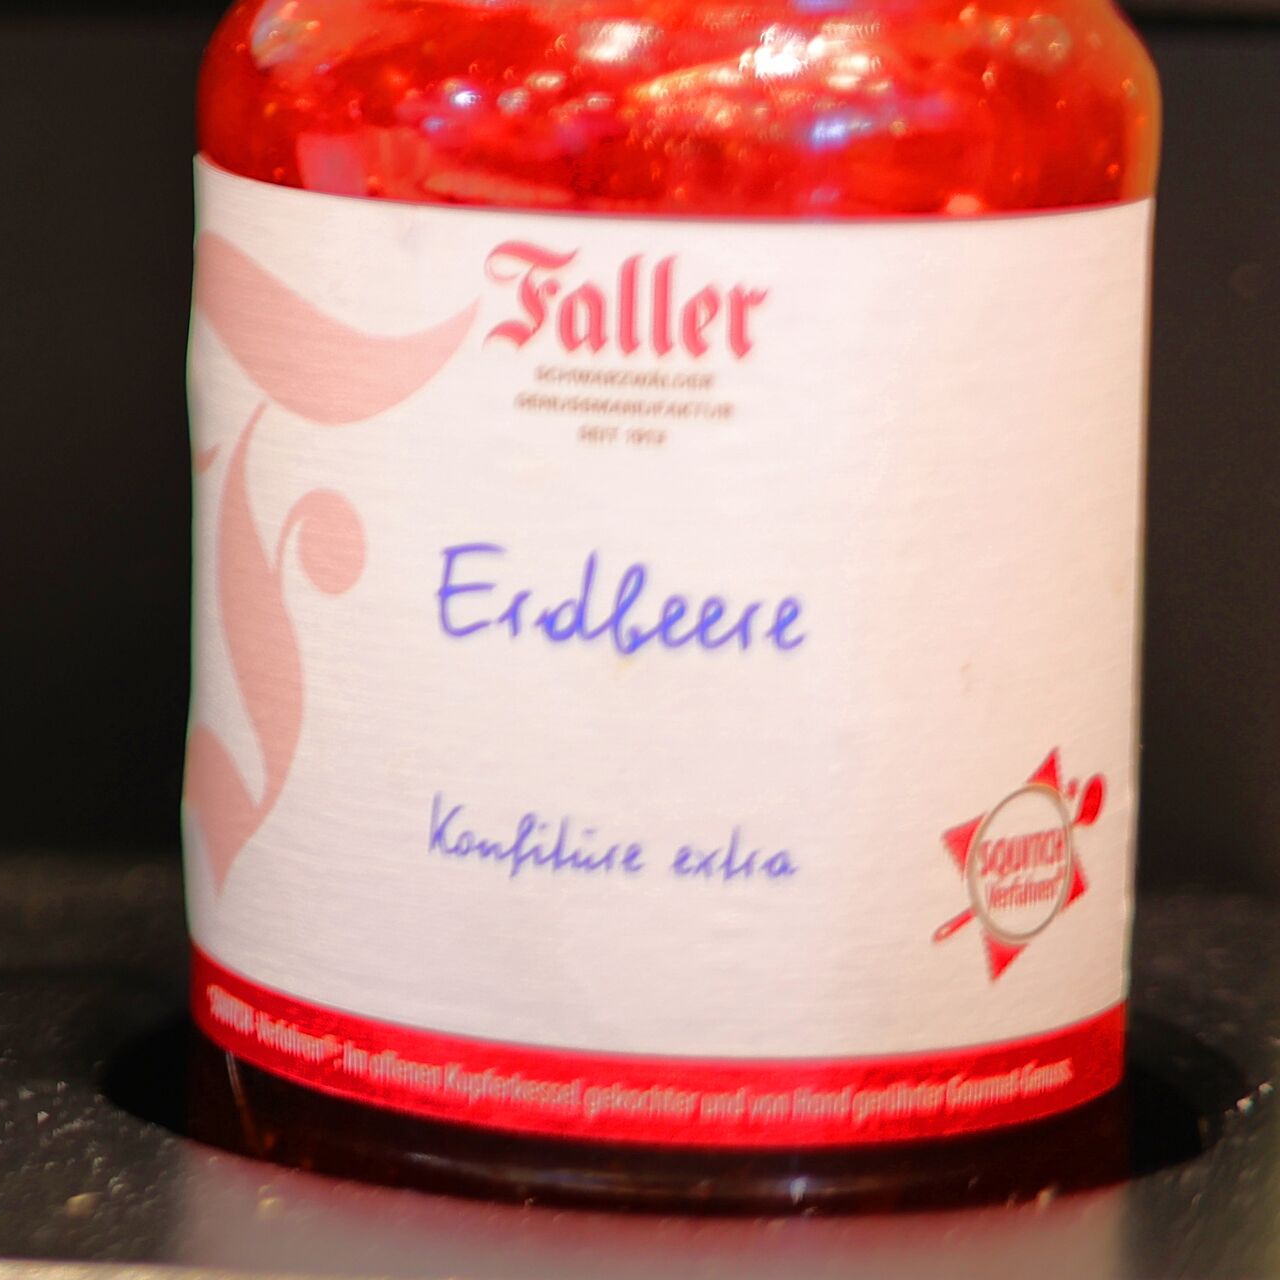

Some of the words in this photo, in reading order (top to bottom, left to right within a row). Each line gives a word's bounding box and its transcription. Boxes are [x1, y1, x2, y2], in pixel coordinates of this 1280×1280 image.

[482, 240, 771, 360] Faller
[436, 540, 809, 657] Erdbeere
[671, 824, 801, 882] extra
[978, 827, 1065, 877] SQUITCH
[443, 1061, 581, 1106] Kupferkessel
[583, 1081, 697, 1123] gekochter
[700, 1086, 747, 1122] und
[749, 1093, 790, 1122] von
[792, 1085, 851, 1121] Hand
